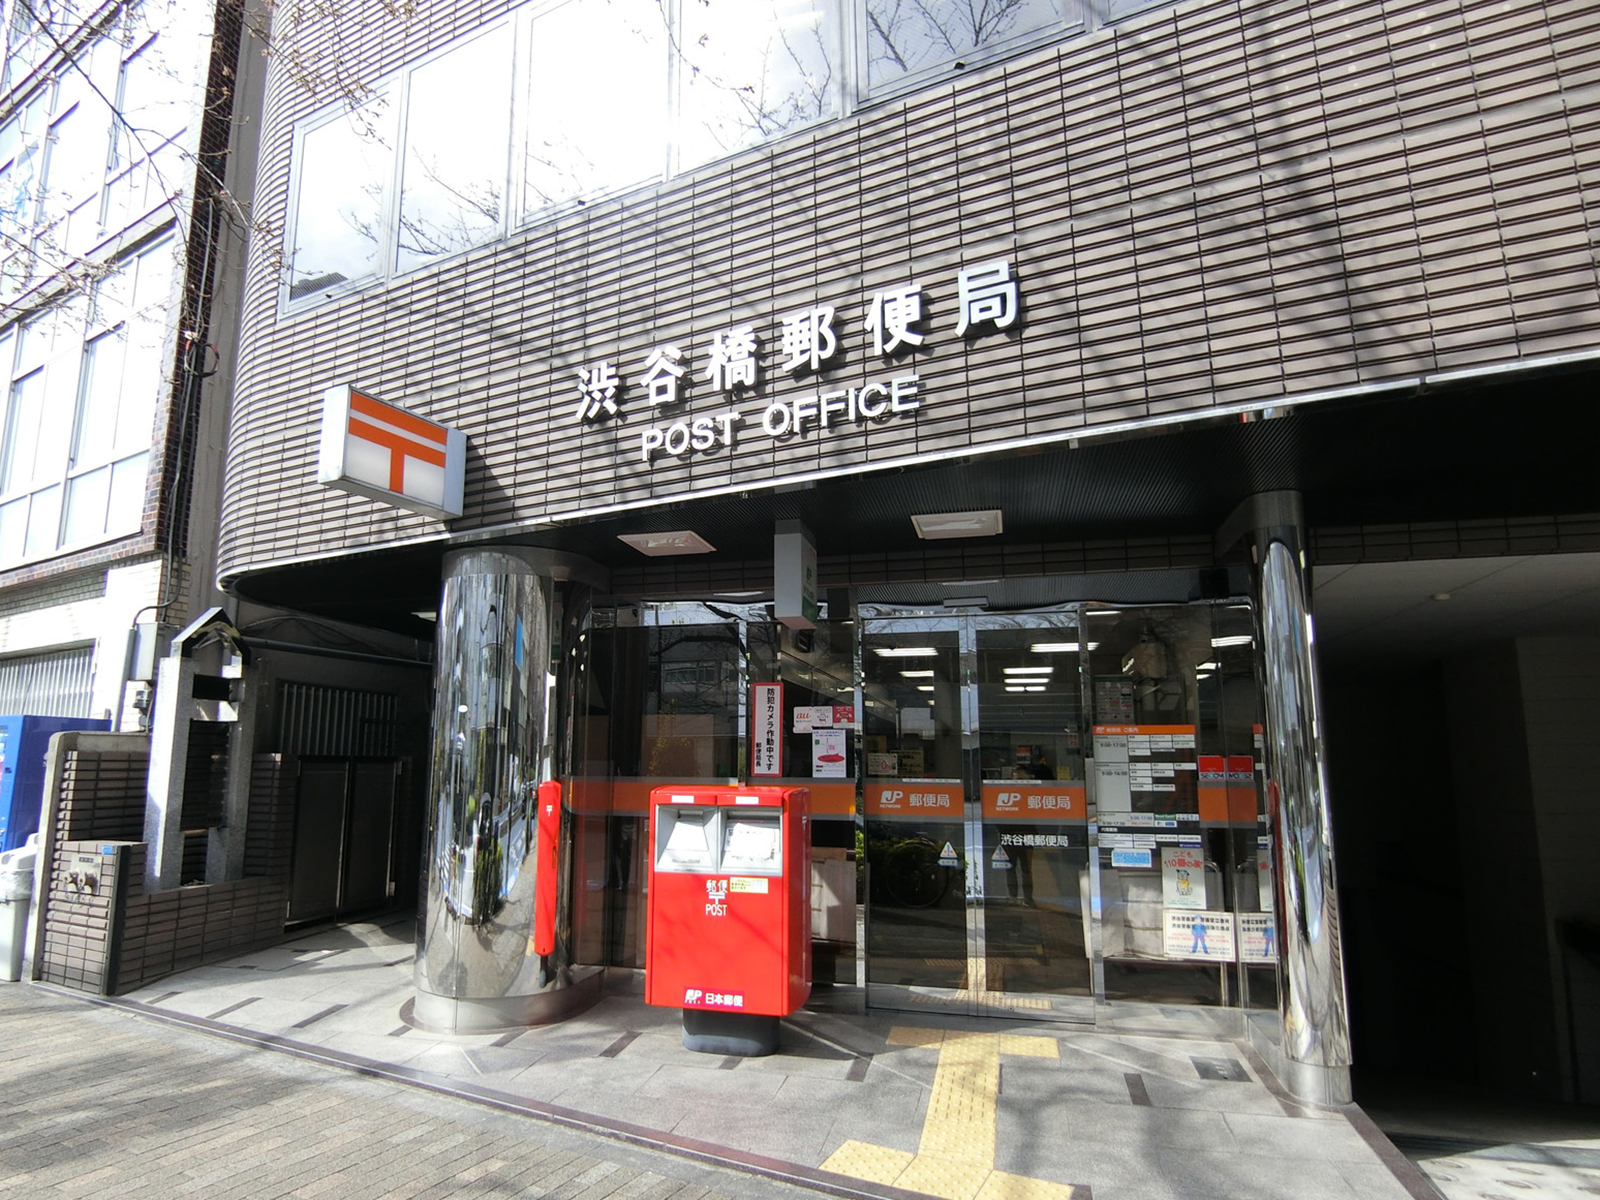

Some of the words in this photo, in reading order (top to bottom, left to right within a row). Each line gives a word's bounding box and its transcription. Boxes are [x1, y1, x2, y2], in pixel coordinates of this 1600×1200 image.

[575, 260, 1020, 420] 渋谷橋郵便局
[641, 411, 742, 461] POST
[762, 373, 921, 437] OFFICE
[766, 687, 775, 771] 防犯カメラ作動中です
[881, 791, 903, 803] JP
[909, 794, 950, 807] 郵便局
[997, 793, 1021, 806] JP
[1027, 796, 1071, 809] 郵便局
[1001, 834, 1068, 846] 渋谷橋郵便局
[1164, 859, 1202, 868] 110番の家
[706, 880, 728, 893] 郵便
[705, 904, 728, 916] POST
[705, 992, 743, 1007] 日本郵便
